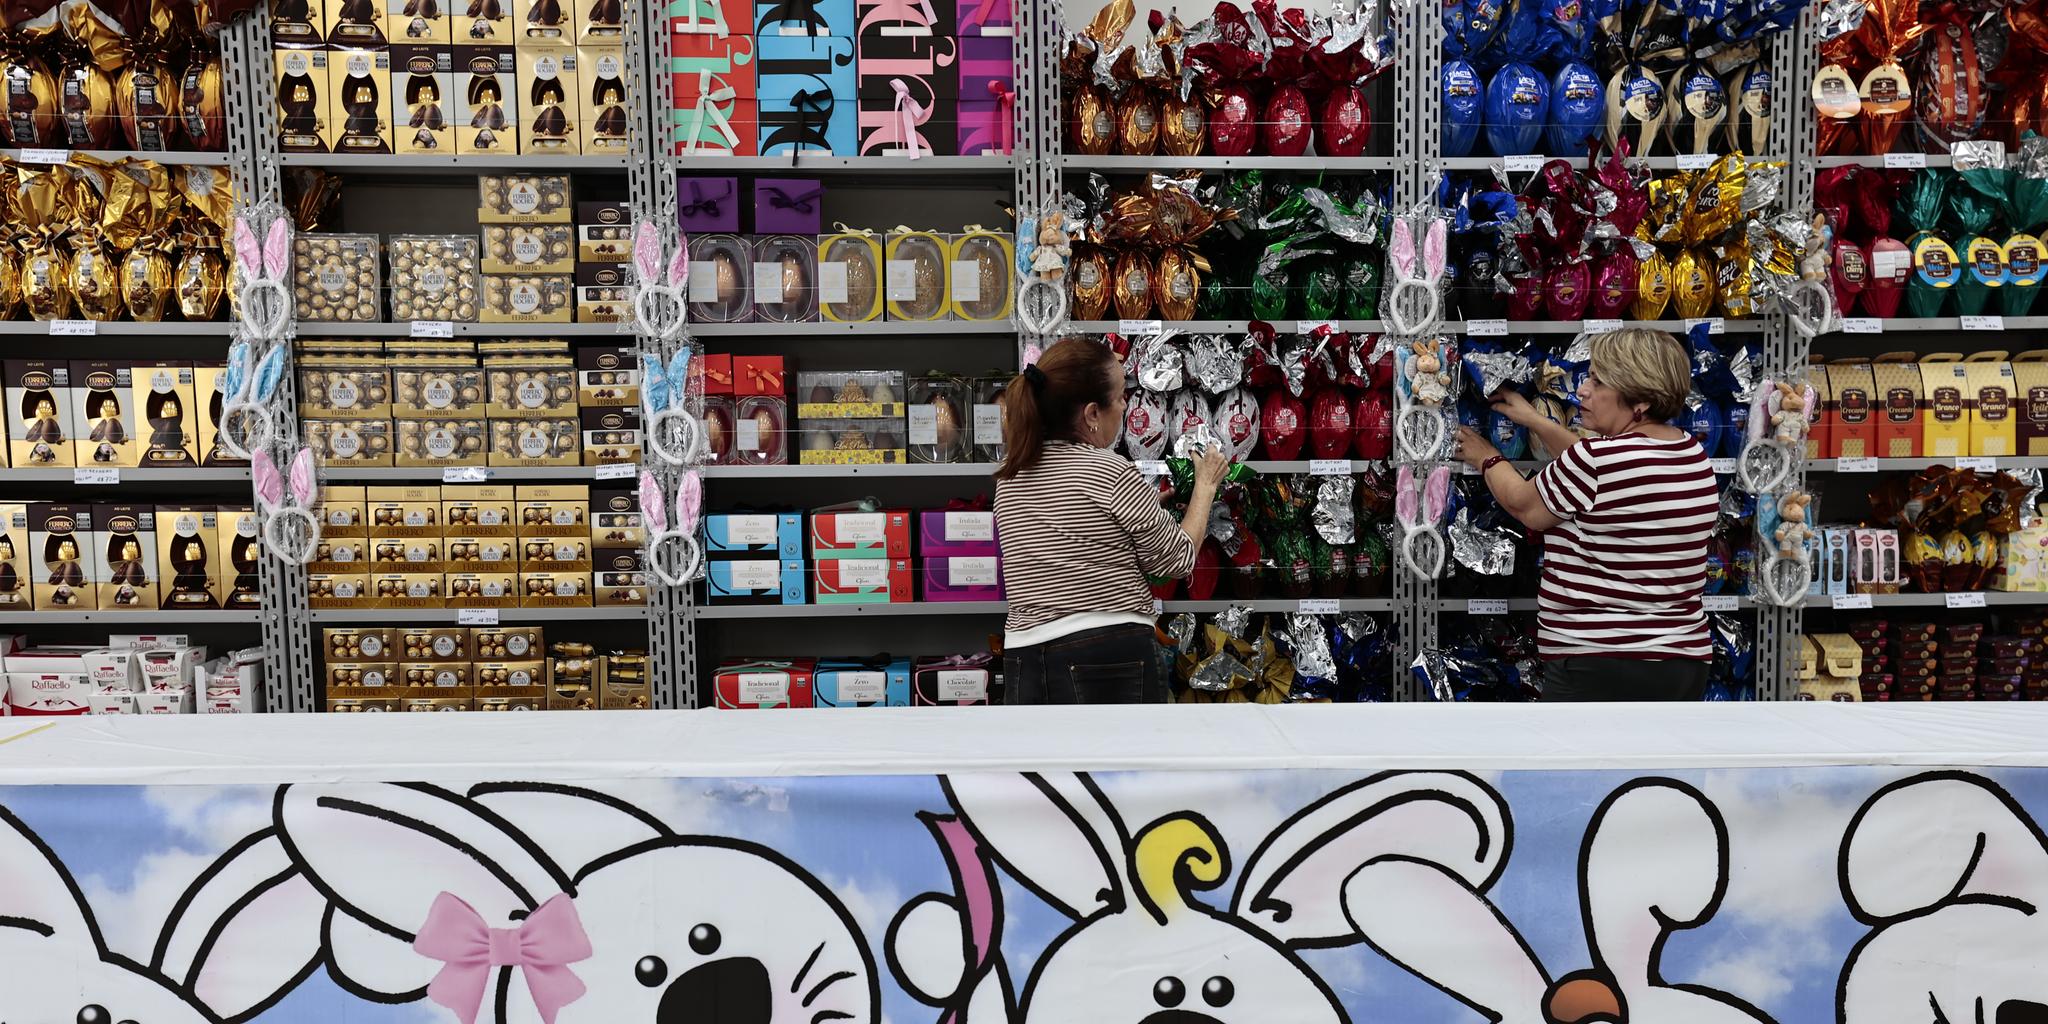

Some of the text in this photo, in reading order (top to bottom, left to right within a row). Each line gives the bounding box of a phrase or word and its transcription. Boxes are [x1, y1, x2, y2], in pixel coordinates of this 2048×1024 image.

[1632, 80, 1650, 88] LACTA
[1693, 77, 1712, 85] LACTA
[1846, 265, 1863, 274] Cherry
[462, 527, 498, 535] FERRERO
[536, 527, 571, 535] FERRERO
[317, 599, 353, 607] FERRERO
[390, 599, 426, 607] FERRERO
[464, 599, 500, 607] FERRERO
[145, 664, 179, 673] Raffaello
[93, 671, 124, 679] Raffaello
[32, 680, 70, 690] Raffaello
[346, 688, 381, 696] FERRERO
[419, 688, 454, 696] FERRERO
[492, 688, 527, 696] FERRERO
